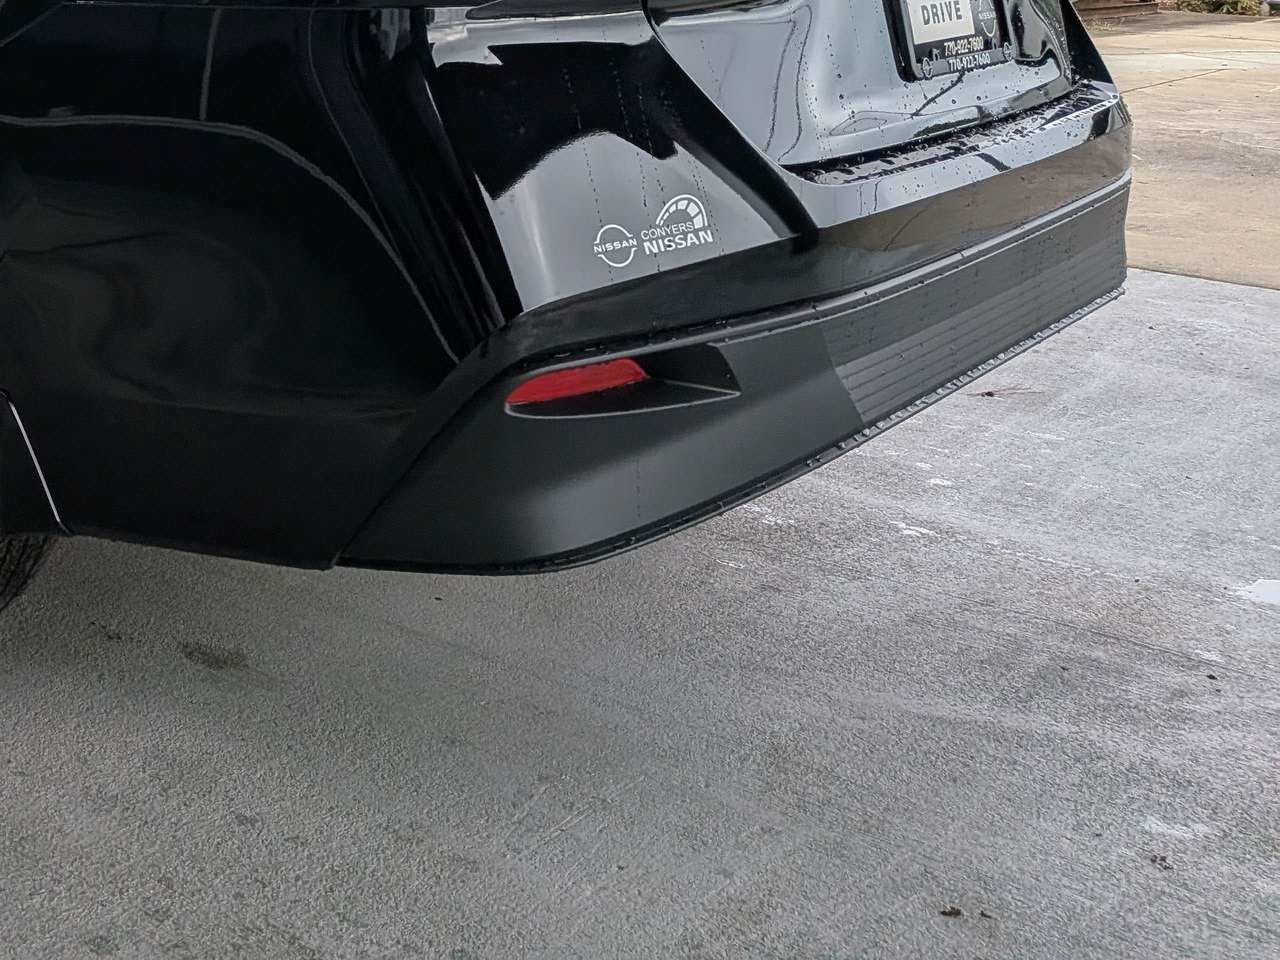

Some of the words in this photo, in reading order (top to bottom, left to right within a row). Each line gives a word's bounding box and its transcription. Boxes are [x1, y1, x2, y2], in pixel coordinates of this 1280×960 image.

[921, 0, 962, 25] DRIVE
[944, 36, 983, 55] 770-922-7600
[593, 237, 637, 253] NISSAN
[643, 230, 713, 255] NISSAN
[641, 223, 694, 240] CONYERS
